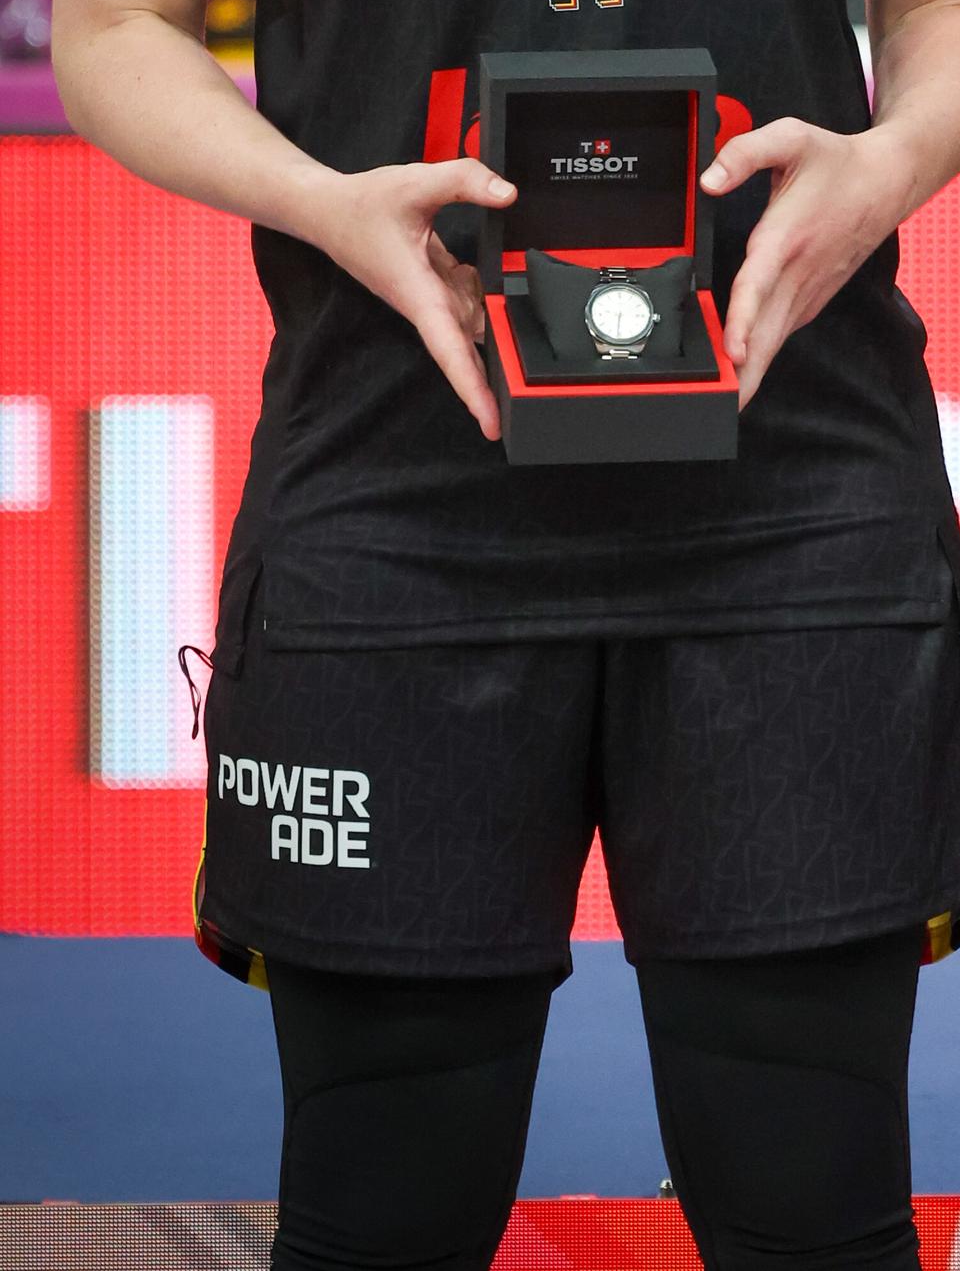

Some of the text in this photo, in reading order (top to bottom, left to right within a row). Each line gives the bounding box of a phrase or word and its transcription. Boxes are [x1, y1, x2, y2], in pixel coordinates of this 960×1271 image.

[551, 157, 638, 173] TISSOT
[218, 753, 370, 818] POWER
[271, 814, 370, 869] ADE
